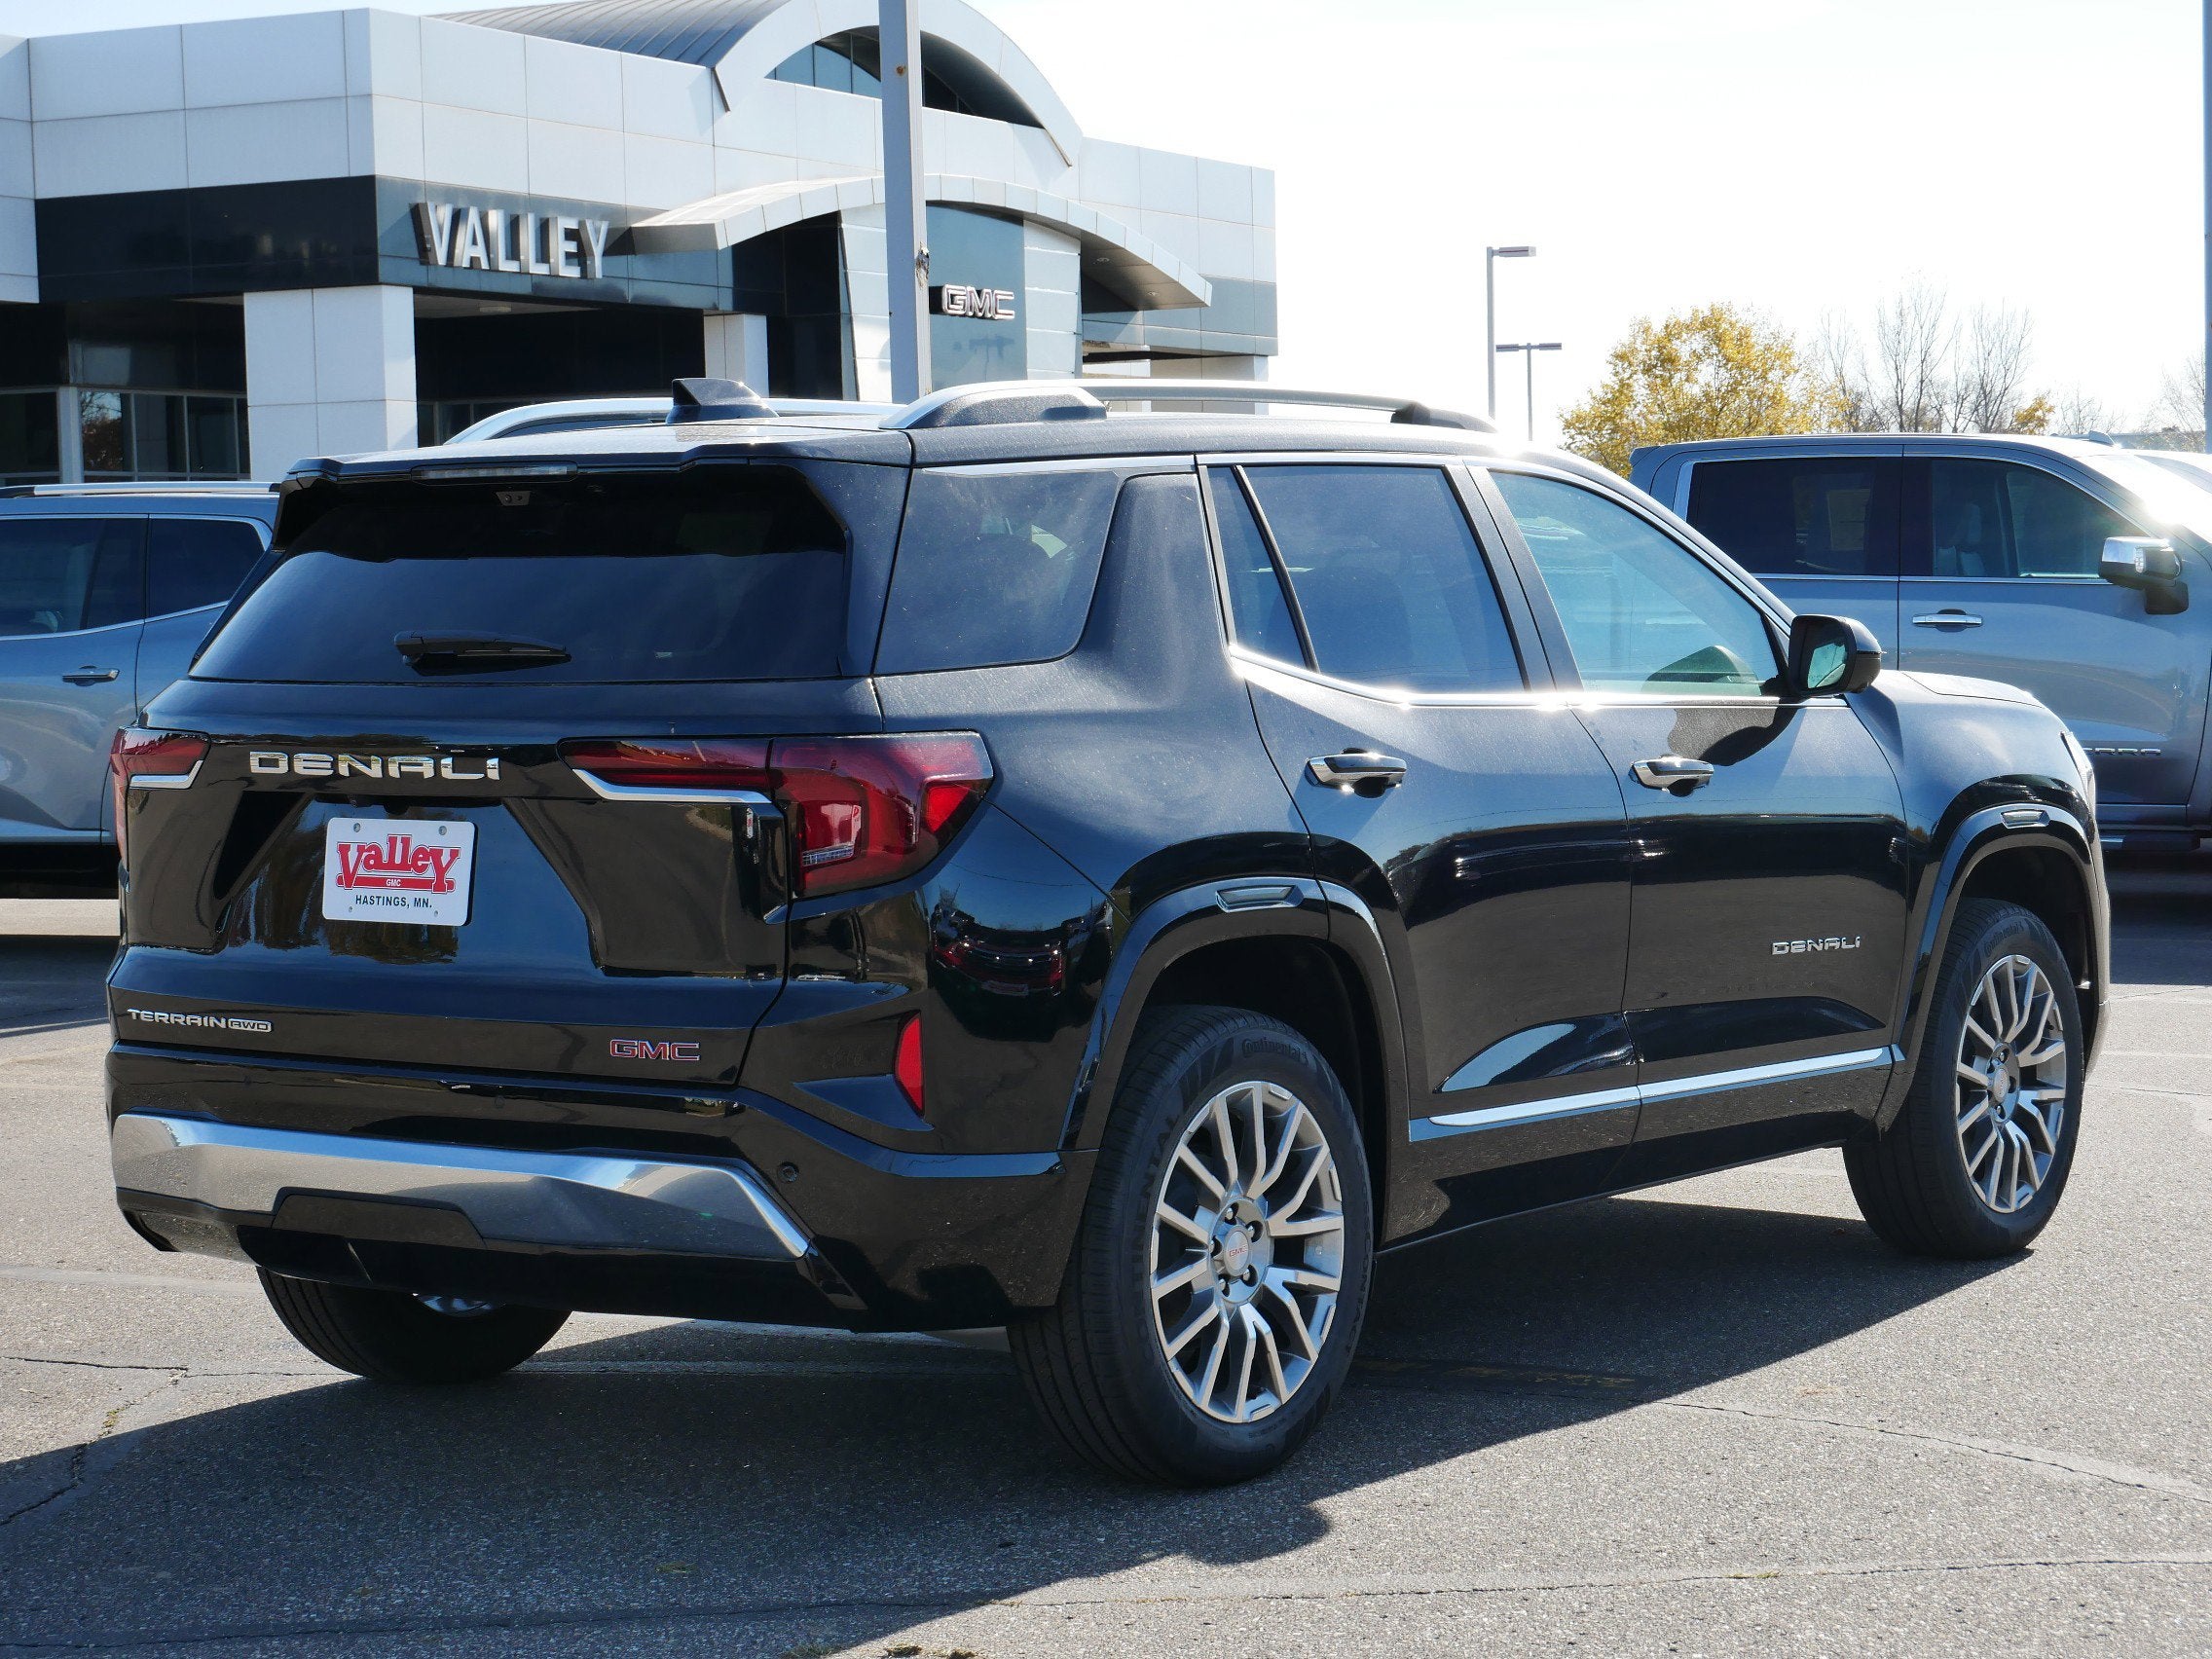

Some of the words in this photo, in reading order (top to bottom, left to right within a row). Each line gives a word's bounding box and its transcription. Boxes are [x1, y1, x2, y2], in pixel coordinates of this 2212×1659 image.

[417, 201, 609, 279] VALLEY
[941, 283, 1015, 319] GMC
[249, 751, 501, 781] DENALI
[336, 833, 461, 894] Valley
[386, 878, 401, 887] GMC
[355, 895, 410, 908] HASTINGS,
[414, 898, 432, 907] MN.
[1772, 936, 1861, 955] DENALI
[127, 1008, 227, 1029] TERRAIN
[228, 1017, 273, 1033] AWD
[609, 1038, 700, 1061] GMC
